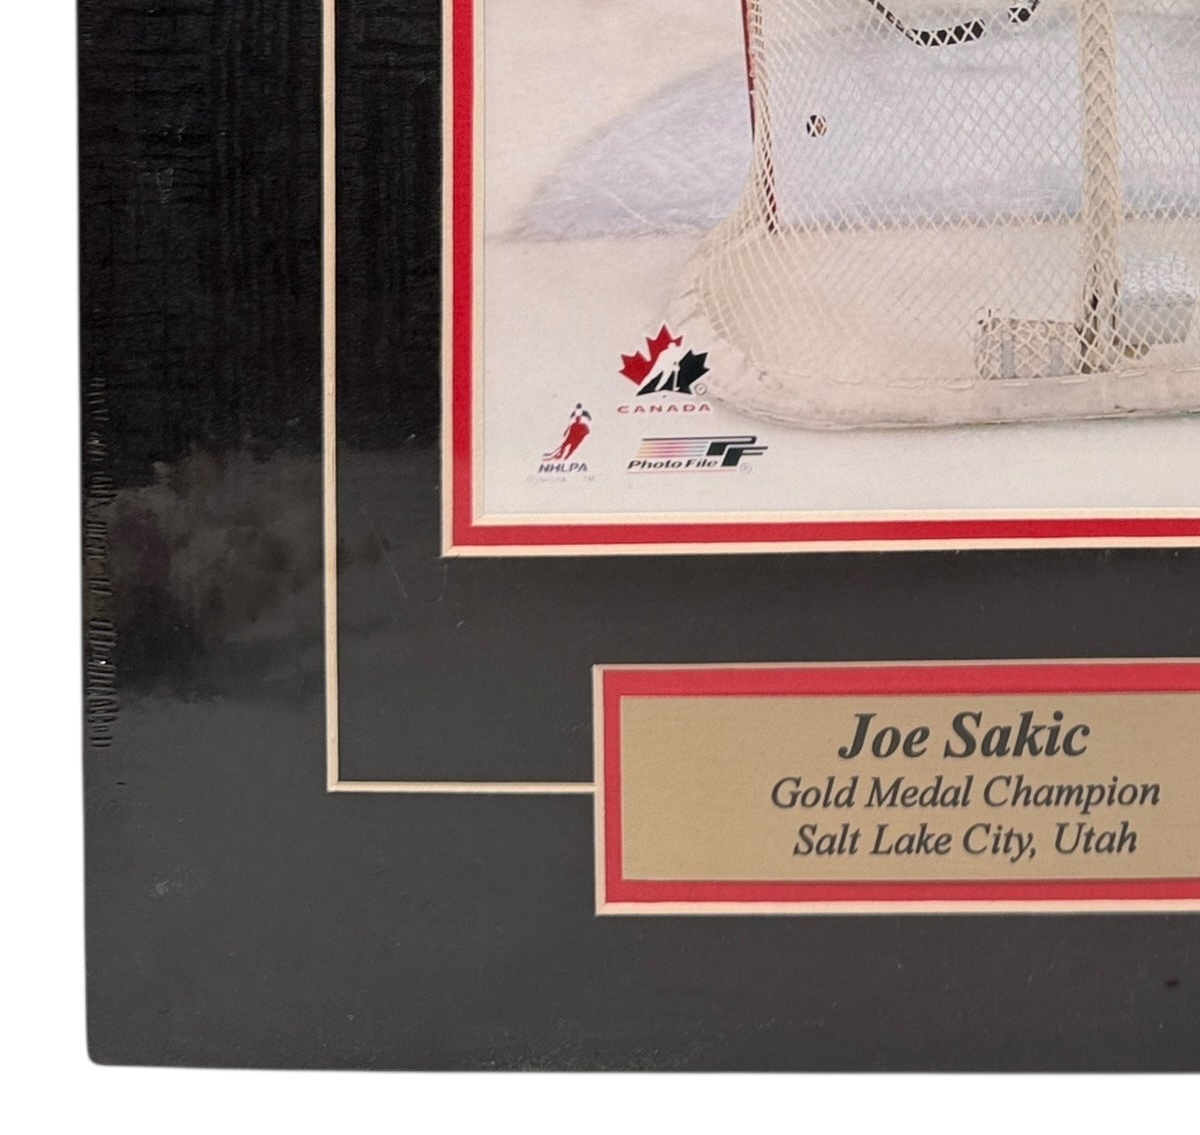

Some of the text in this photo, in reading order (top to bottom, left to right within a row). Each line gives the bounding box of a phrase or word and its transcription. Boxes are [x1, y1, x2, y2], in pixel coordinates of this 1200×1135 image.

[617, 403, 711, 414] CANADA
[538, 462, 588, 473] NHLPA
[627, 458, 719, 470] Photo File
[837, 709, 1091, 760] Joe Sakic
[769, 774, 1162, 815] Gold Medal Champion
[792, 820, 1139, 863] Salt Lake City, Utah
